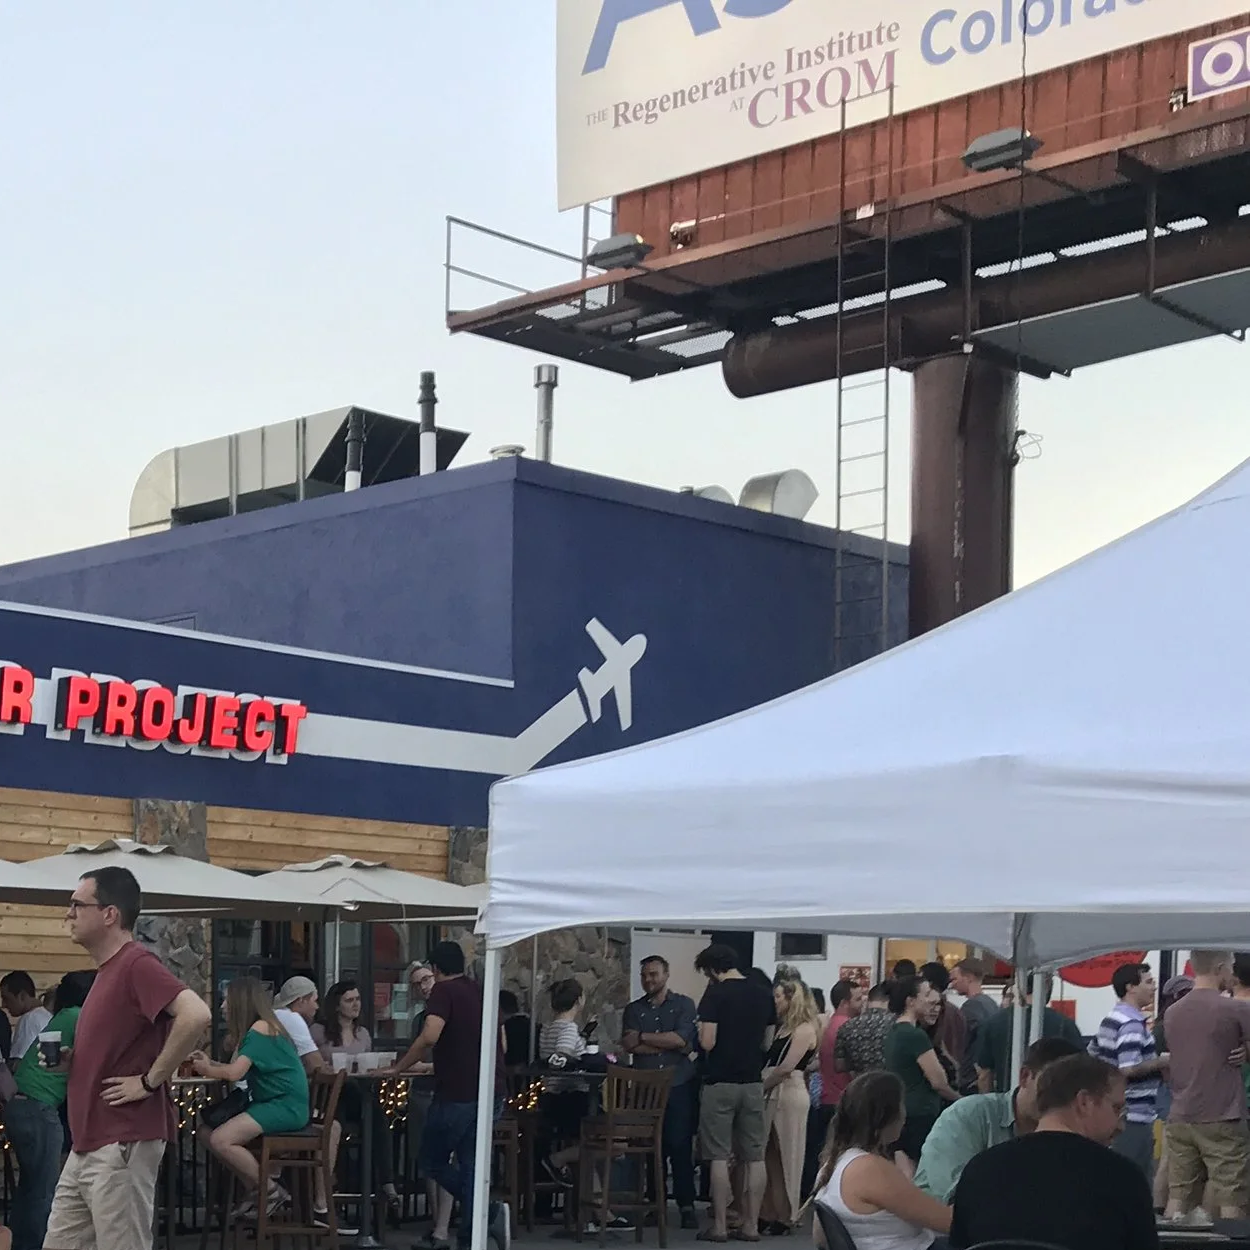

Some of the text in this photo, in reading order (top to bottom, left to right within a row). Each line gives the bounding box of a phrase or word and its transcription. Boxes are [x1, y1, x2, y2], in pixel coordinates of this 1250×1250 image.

[585, 20, 900, 129] THE Regenerative Institute
[729, 48, 900, 129] AT CROM
[57, 674, 308, 756] PROJECT
